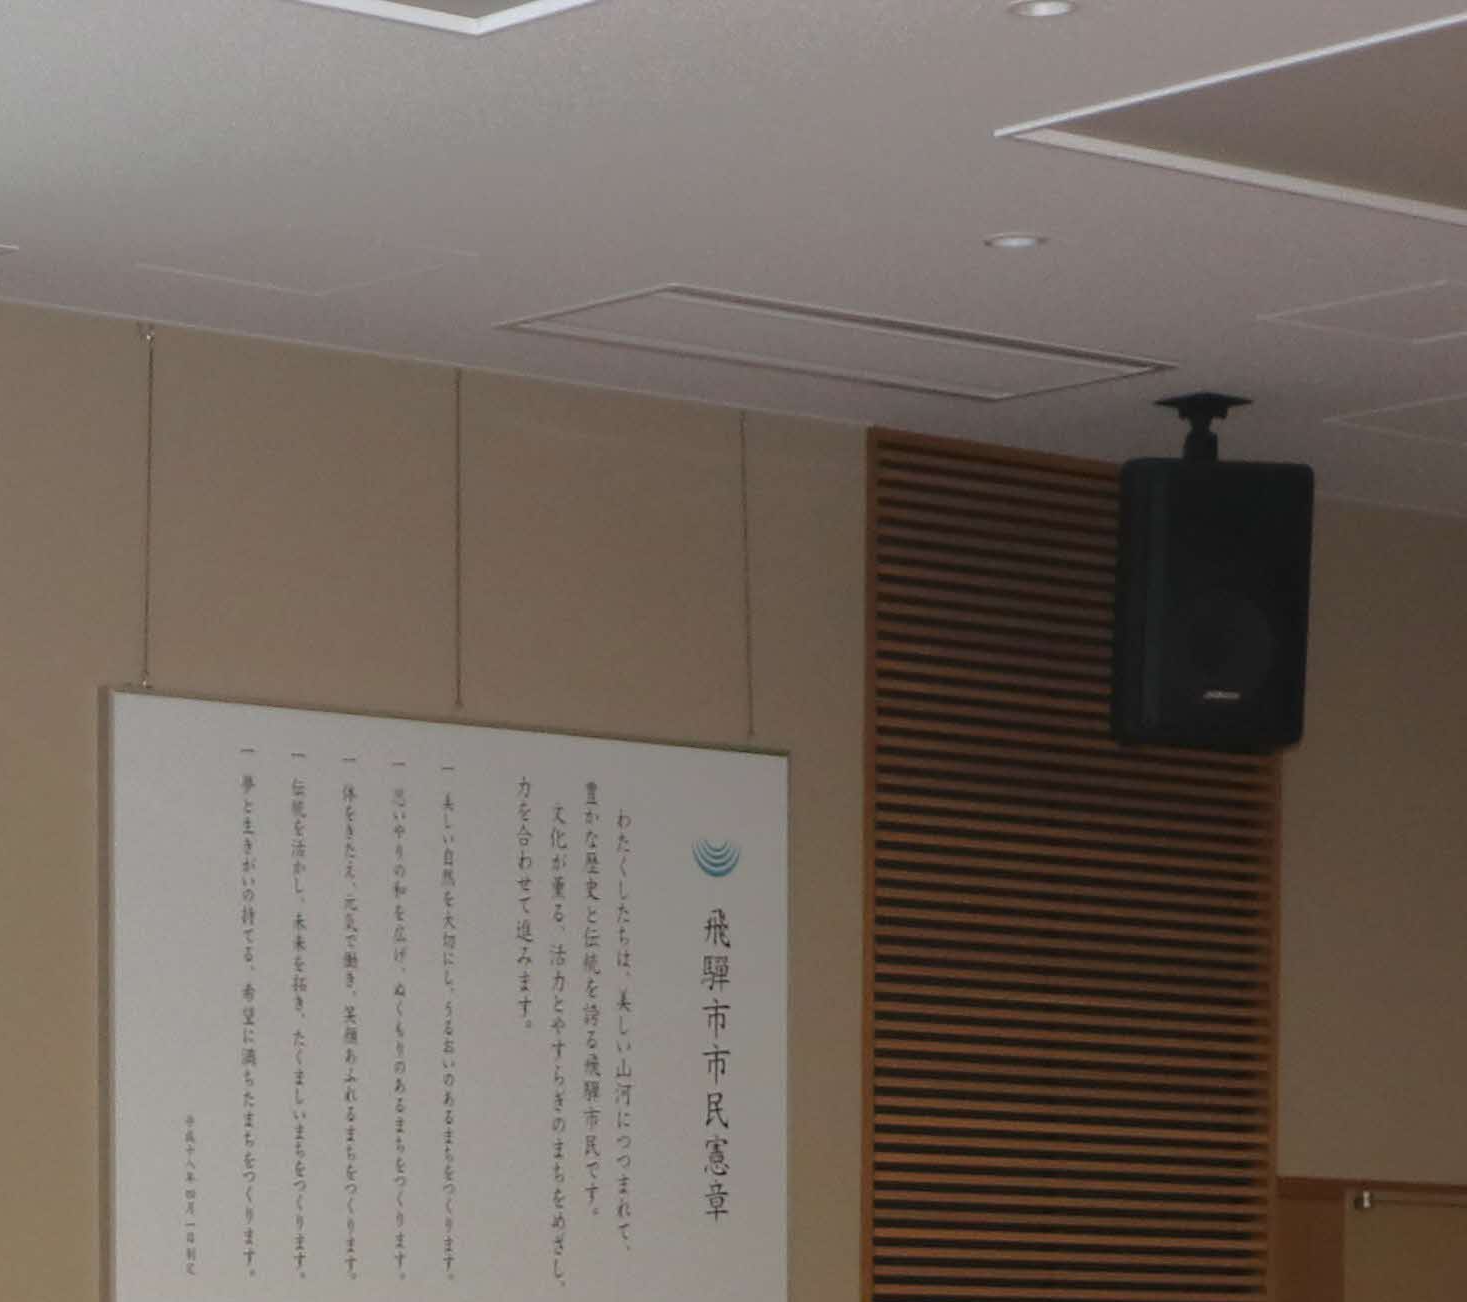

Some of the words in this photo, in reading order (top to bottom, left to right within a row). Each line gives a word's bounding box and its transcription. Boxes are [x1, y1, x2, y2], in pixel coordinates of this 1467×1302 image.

[514, 775, 535, 1029] 力を合わせて進みます。
